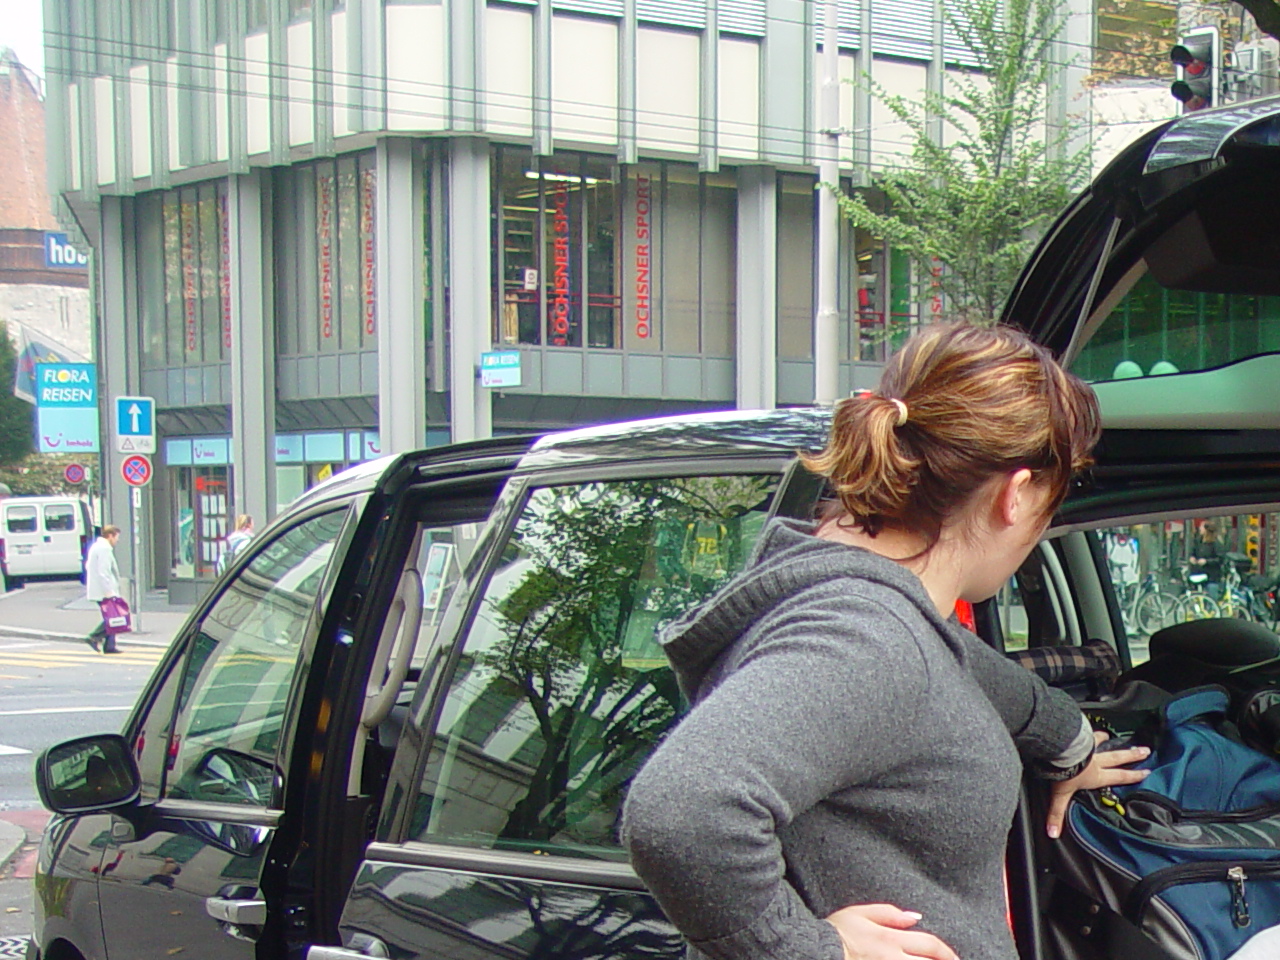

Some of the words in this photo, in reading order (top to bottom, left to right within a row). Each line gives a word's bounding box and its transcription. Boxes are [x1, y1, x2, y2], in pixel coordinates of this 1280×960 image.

[636, 173, 649, 239] SPORT
[322, 246, 331, 338] OCHSNER
[366, 240, 374, 335] OCHSNER
[555, 237, 570, 334] OCHSNER
[636, 244, 649, 339] OCHSNER
[42, 388, 93, 402] REISEN
[44, 369, 90, 383] FLORA
